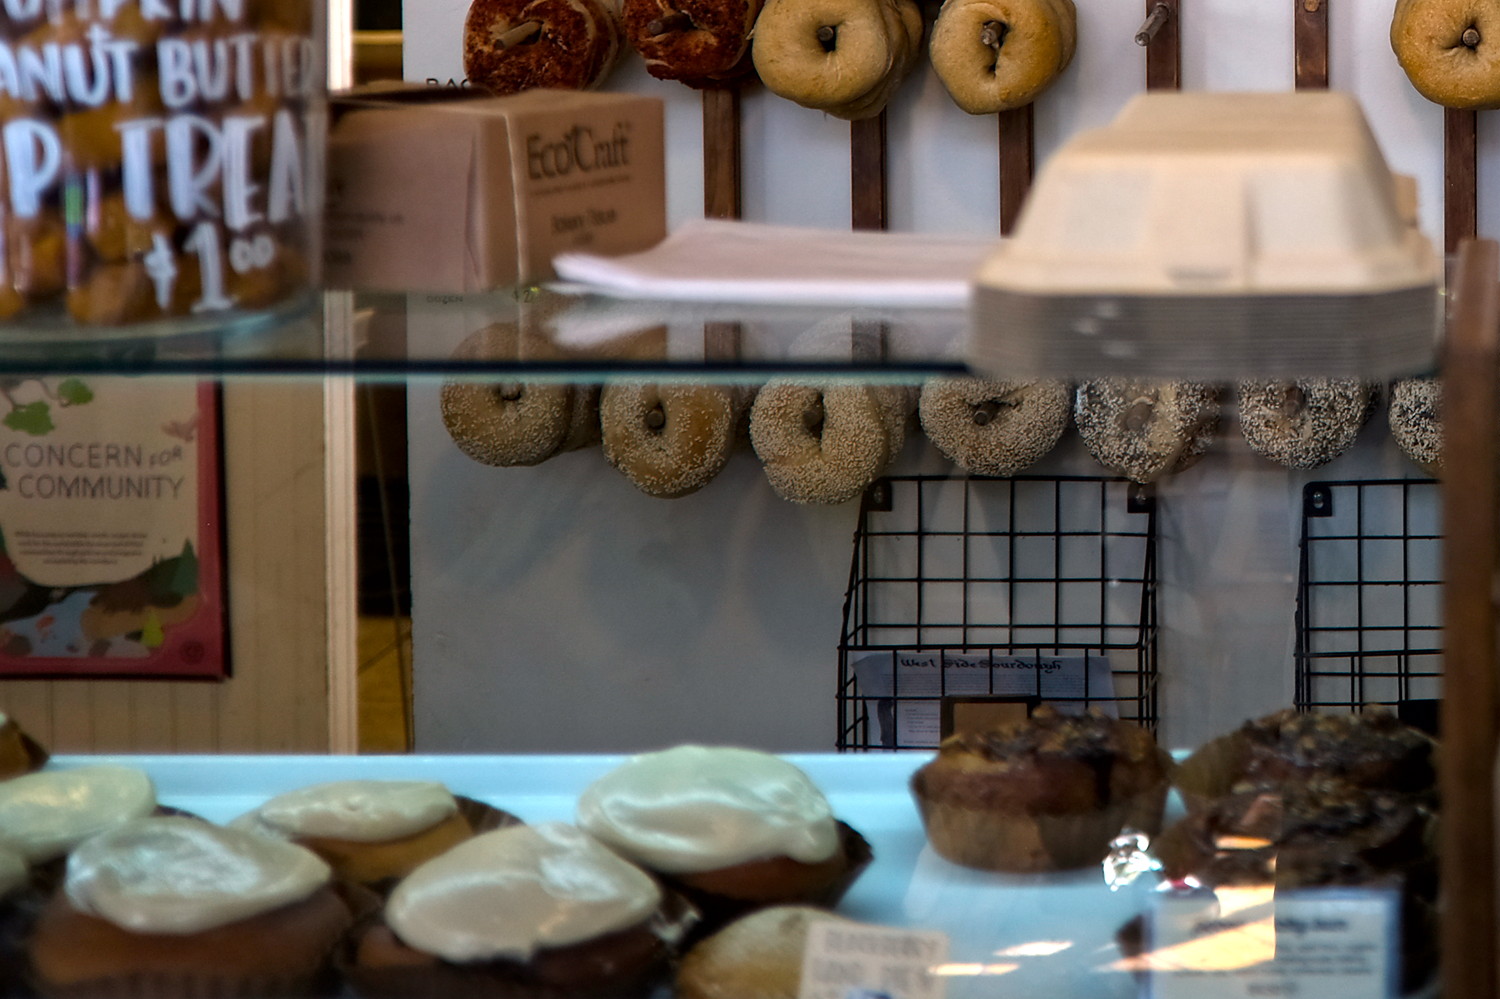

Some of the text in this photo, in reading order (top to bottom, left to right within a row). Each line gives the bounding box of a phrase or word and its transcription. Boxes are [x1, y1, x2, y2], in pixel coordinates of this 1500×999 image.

[114, 110, 306, 232] TREA
[5, 443, 143, 469] CONCERN
[18, 474, 184, 499] COMMUNITY
